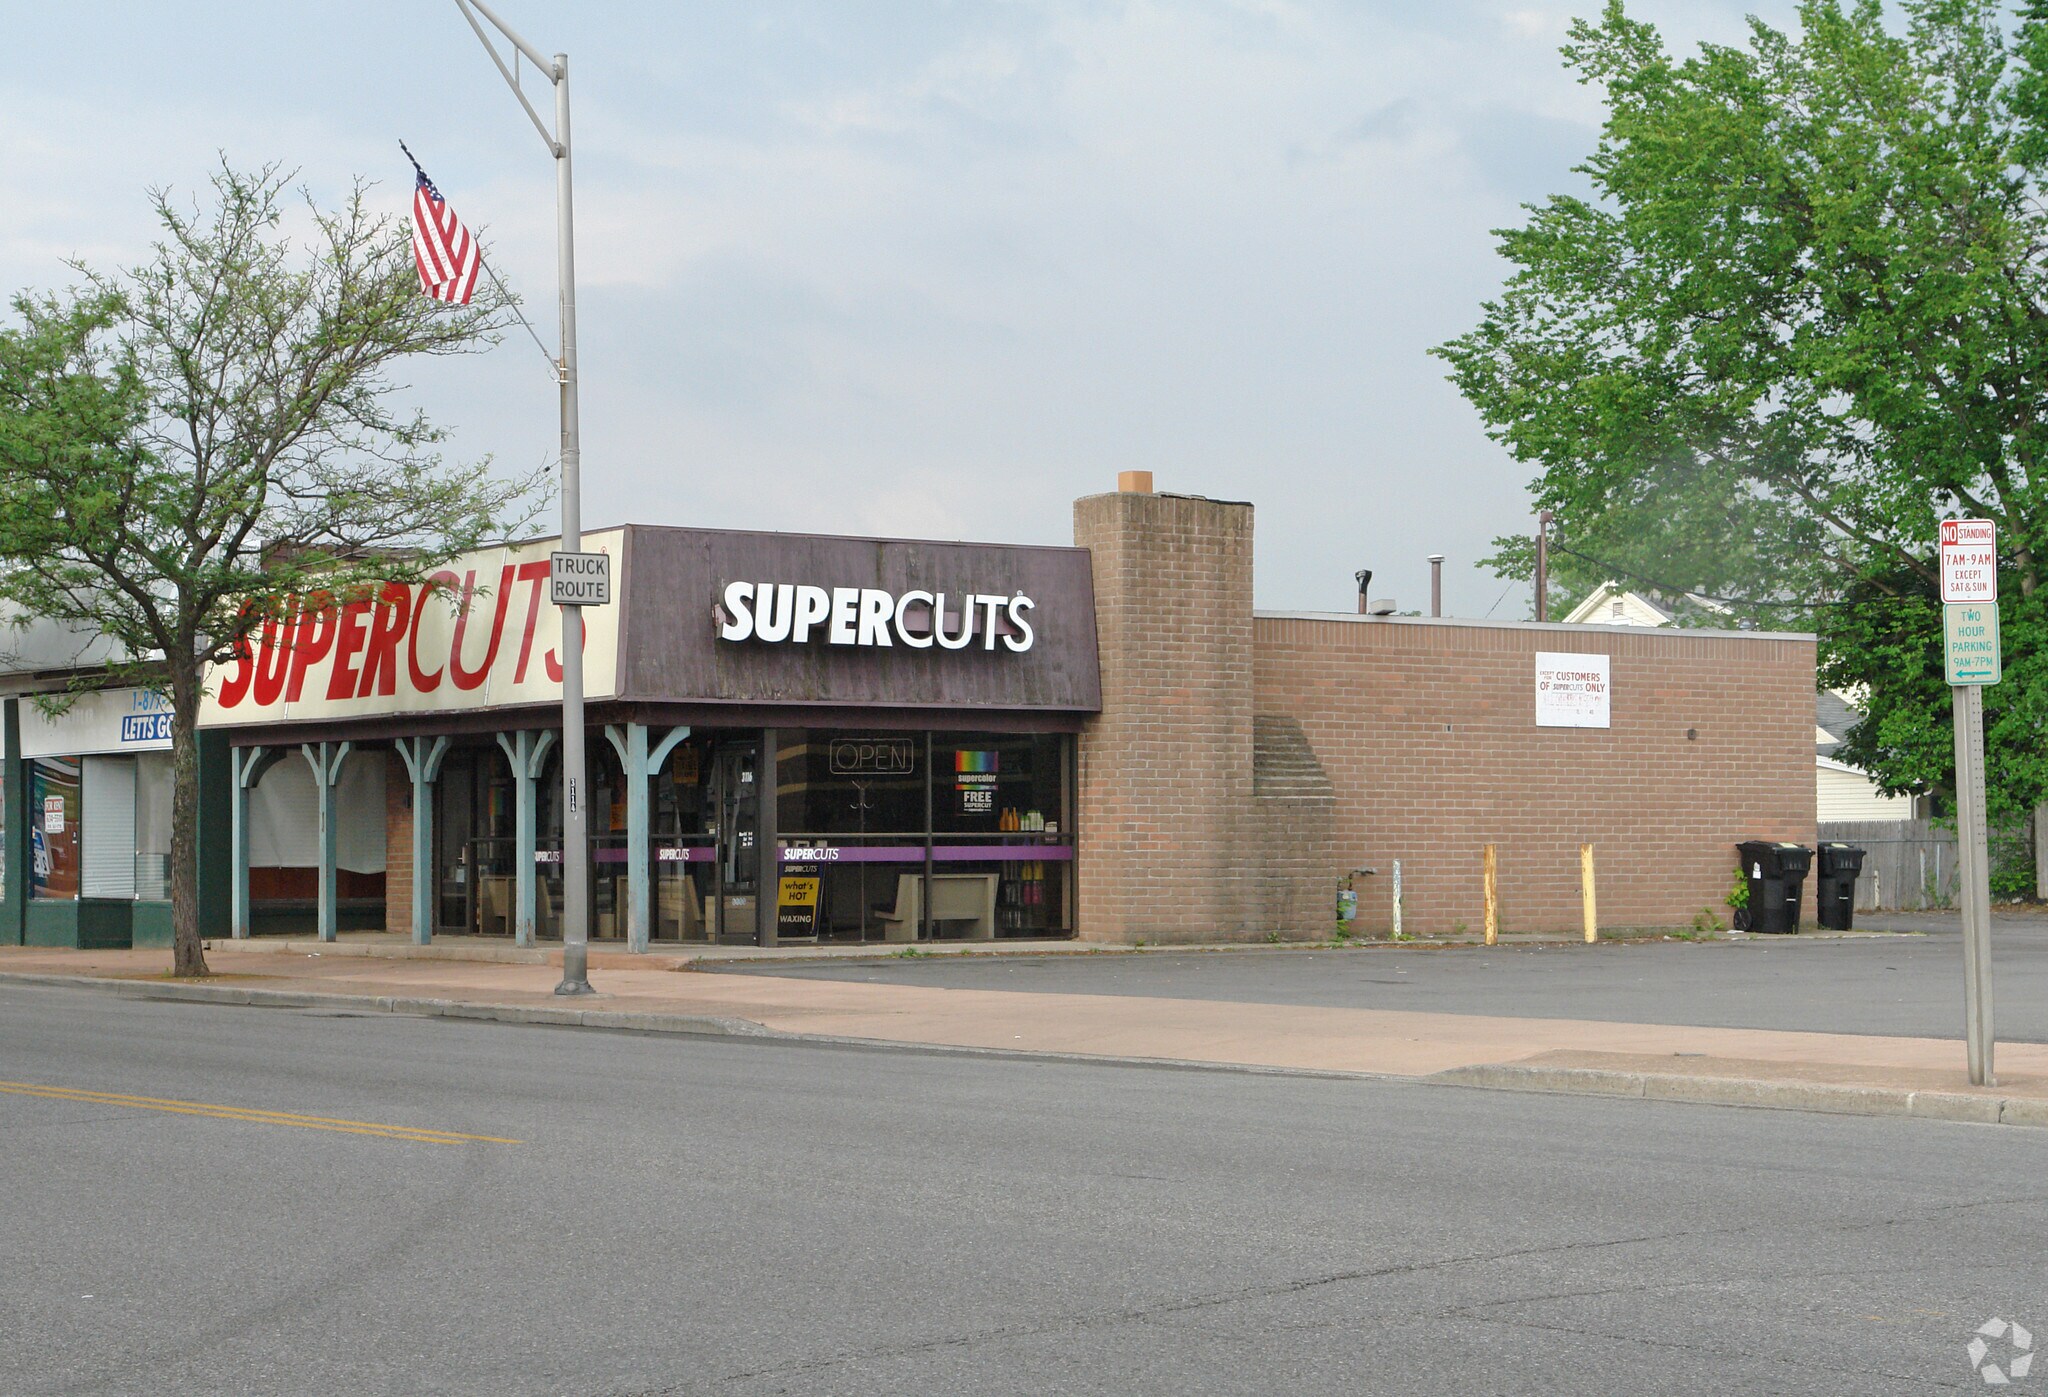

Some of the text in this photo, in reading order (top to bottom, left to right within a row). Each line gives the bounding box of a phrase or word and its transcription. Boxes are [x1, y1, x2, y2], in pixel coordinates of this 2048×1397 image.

[1943, 526, 1991, 542] NO STANDING
[555, 558, 605, 575] TRUCK
[1955, 569, 1982, 579] EXCEPT
[555, 581, 605, 597] ROUTE
[721, 581, 1036, 653] SUPERCUTS
[1961, 611, 1981, 622] TWO
[1958, 626, 1985, 636] HOUR
[1952, 641, 1992, 653] PARKING
[1953, 657, 1993, 667] 9AM-7PM
[1556, 671, 1600, 682] CUSTOMERS
[1540, 682, 1550, 691] OF
[1585, 683, 1605, 692] ONLY
[124, 716, 155, 740] LETTS
[835, 742, 906, 770] OPEN
[957, 773, 997, 783] supercolor
[963, 791, 992, 802] FREE
[659, 848, 690, 860] SUPERCUTS
[784, 848, 839, 860] SUPERCUTS
[784, 865, 818, 873] SUPERCUTS
[785, 881, 813, 890] what's
[789, 891, 807, 900] HOT
[780, 915, 811, 923] WAXING
